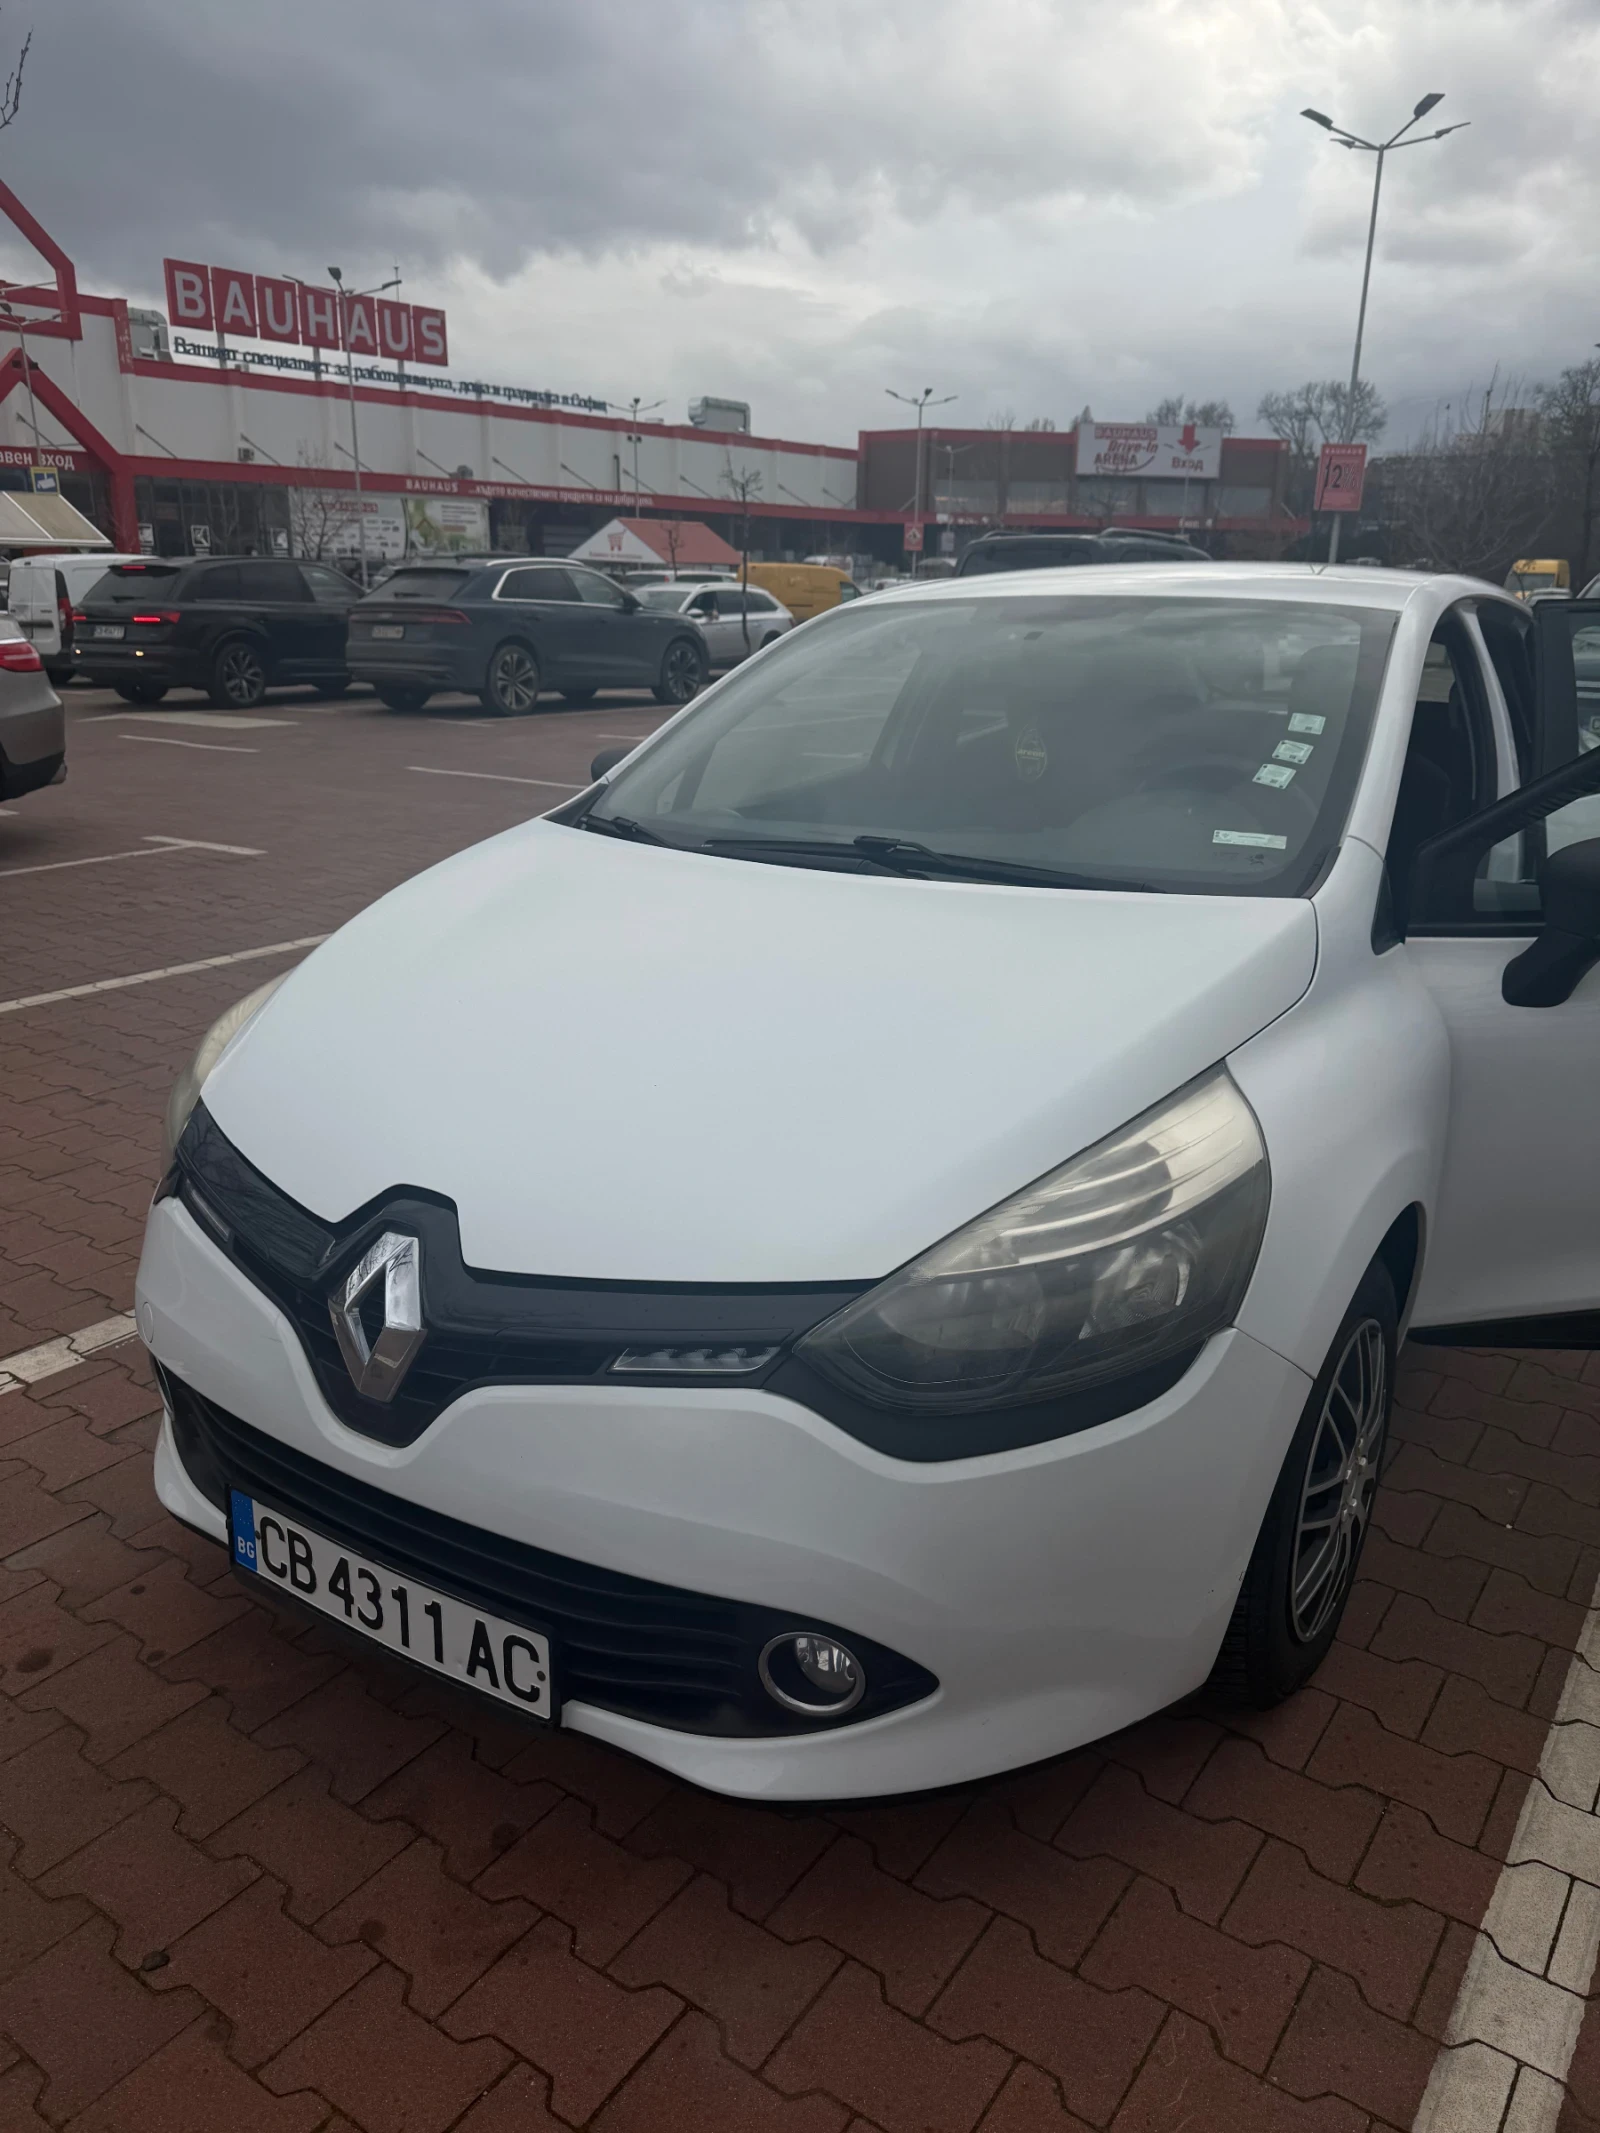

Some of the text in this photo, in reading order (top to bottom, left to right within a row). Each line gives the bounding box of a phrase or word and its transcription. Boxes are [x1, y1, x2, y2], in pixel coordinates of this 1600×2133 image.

[174, 270, 444, 356] BAUHAUS
[174, 336, 237, 361] Вашият
[243, 350, 331, 373] специалист
[1094, 424, 1158, 440] BAUHAUS
[1171, 456, 1204, 472] Вход
[405, 479, 459, 494] BAUHAUS
[237, 1536, 255, 1559] BG
[260, 1516, 541, 1702] CB 4311 AC
